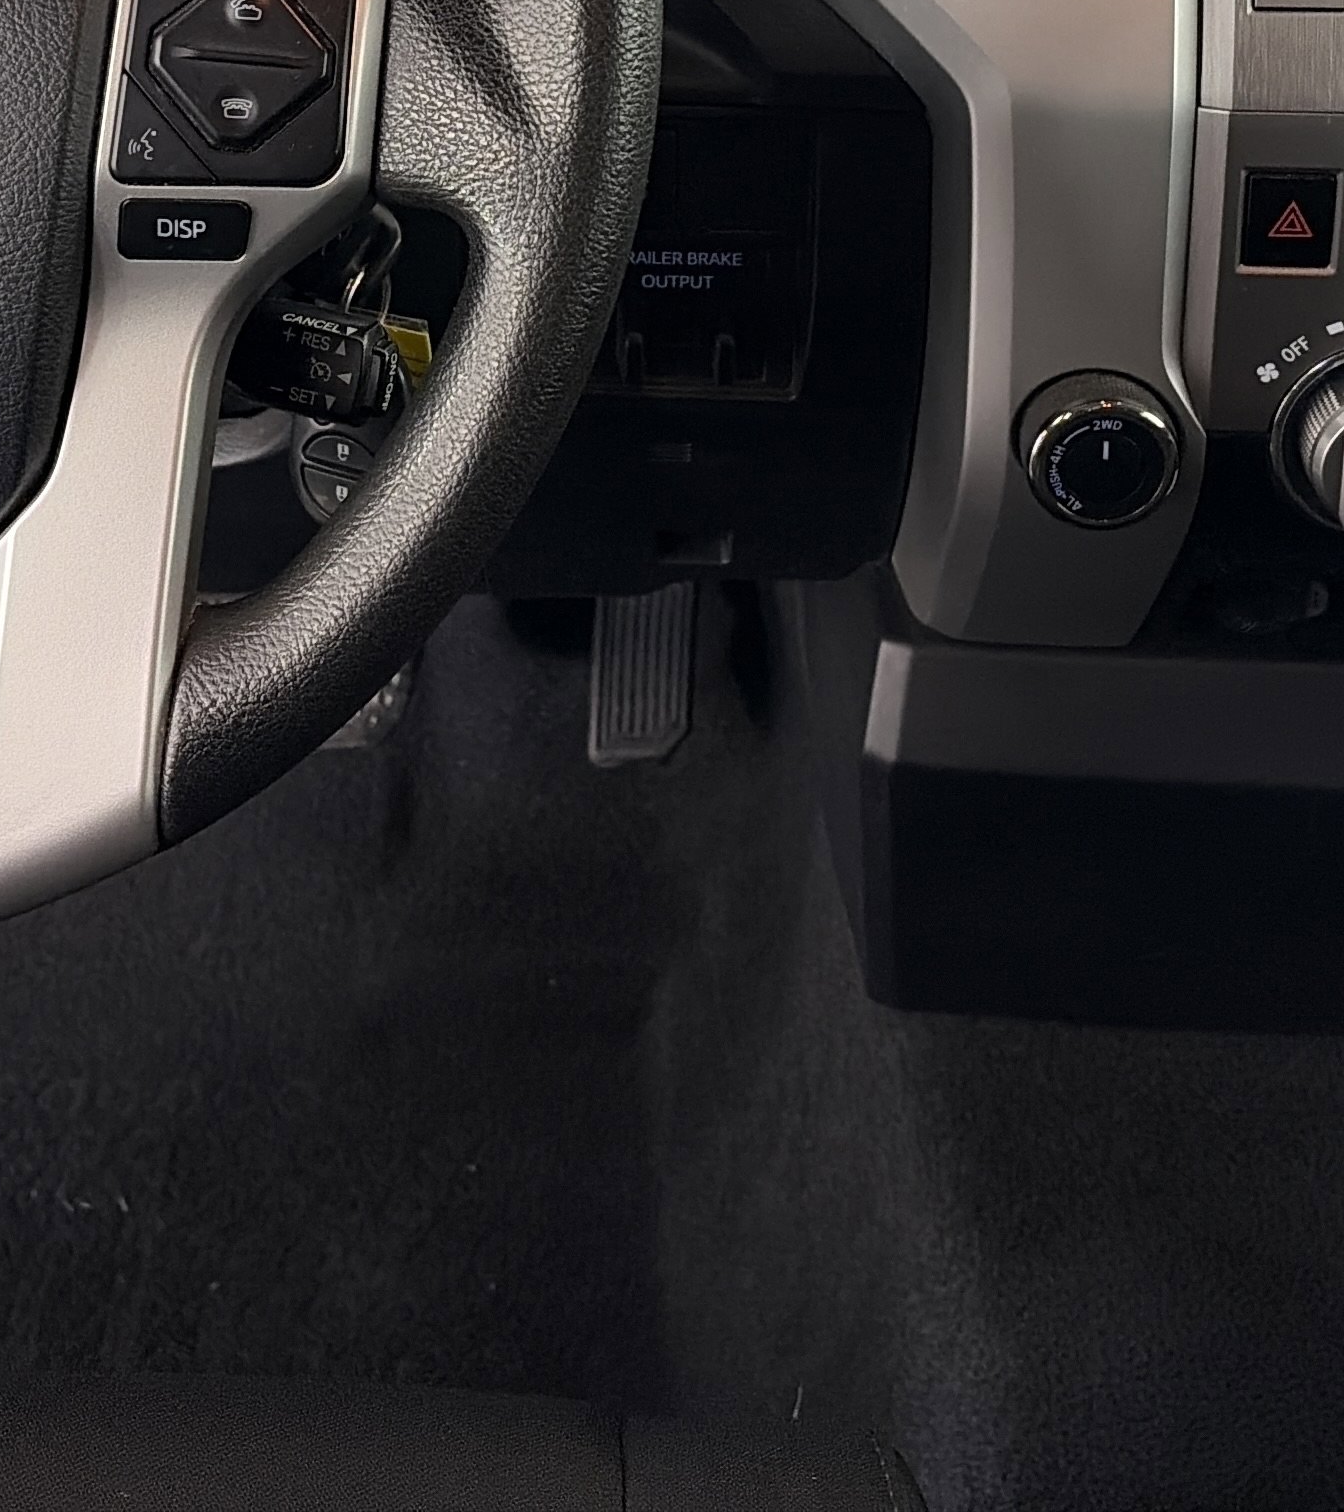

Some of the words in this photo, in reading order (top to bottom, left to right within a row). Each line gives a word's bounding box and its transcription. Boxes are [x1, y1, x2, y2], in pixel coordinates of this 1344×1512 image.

[156, 218, 207, 240] DISP
[628, 251, 684, 265] RAILER
[687, 251, 744, 267] BRAKE
[641, 274, 715, 289] OUTPUT
[281, 312, 342, 336] CANCEL
[301, 331, 331, 352] RES
[1280, 335, 1311, 363] OFF
[288, 386, 318, 406] SET
[1092, 419, 1123, 432] 2WD
